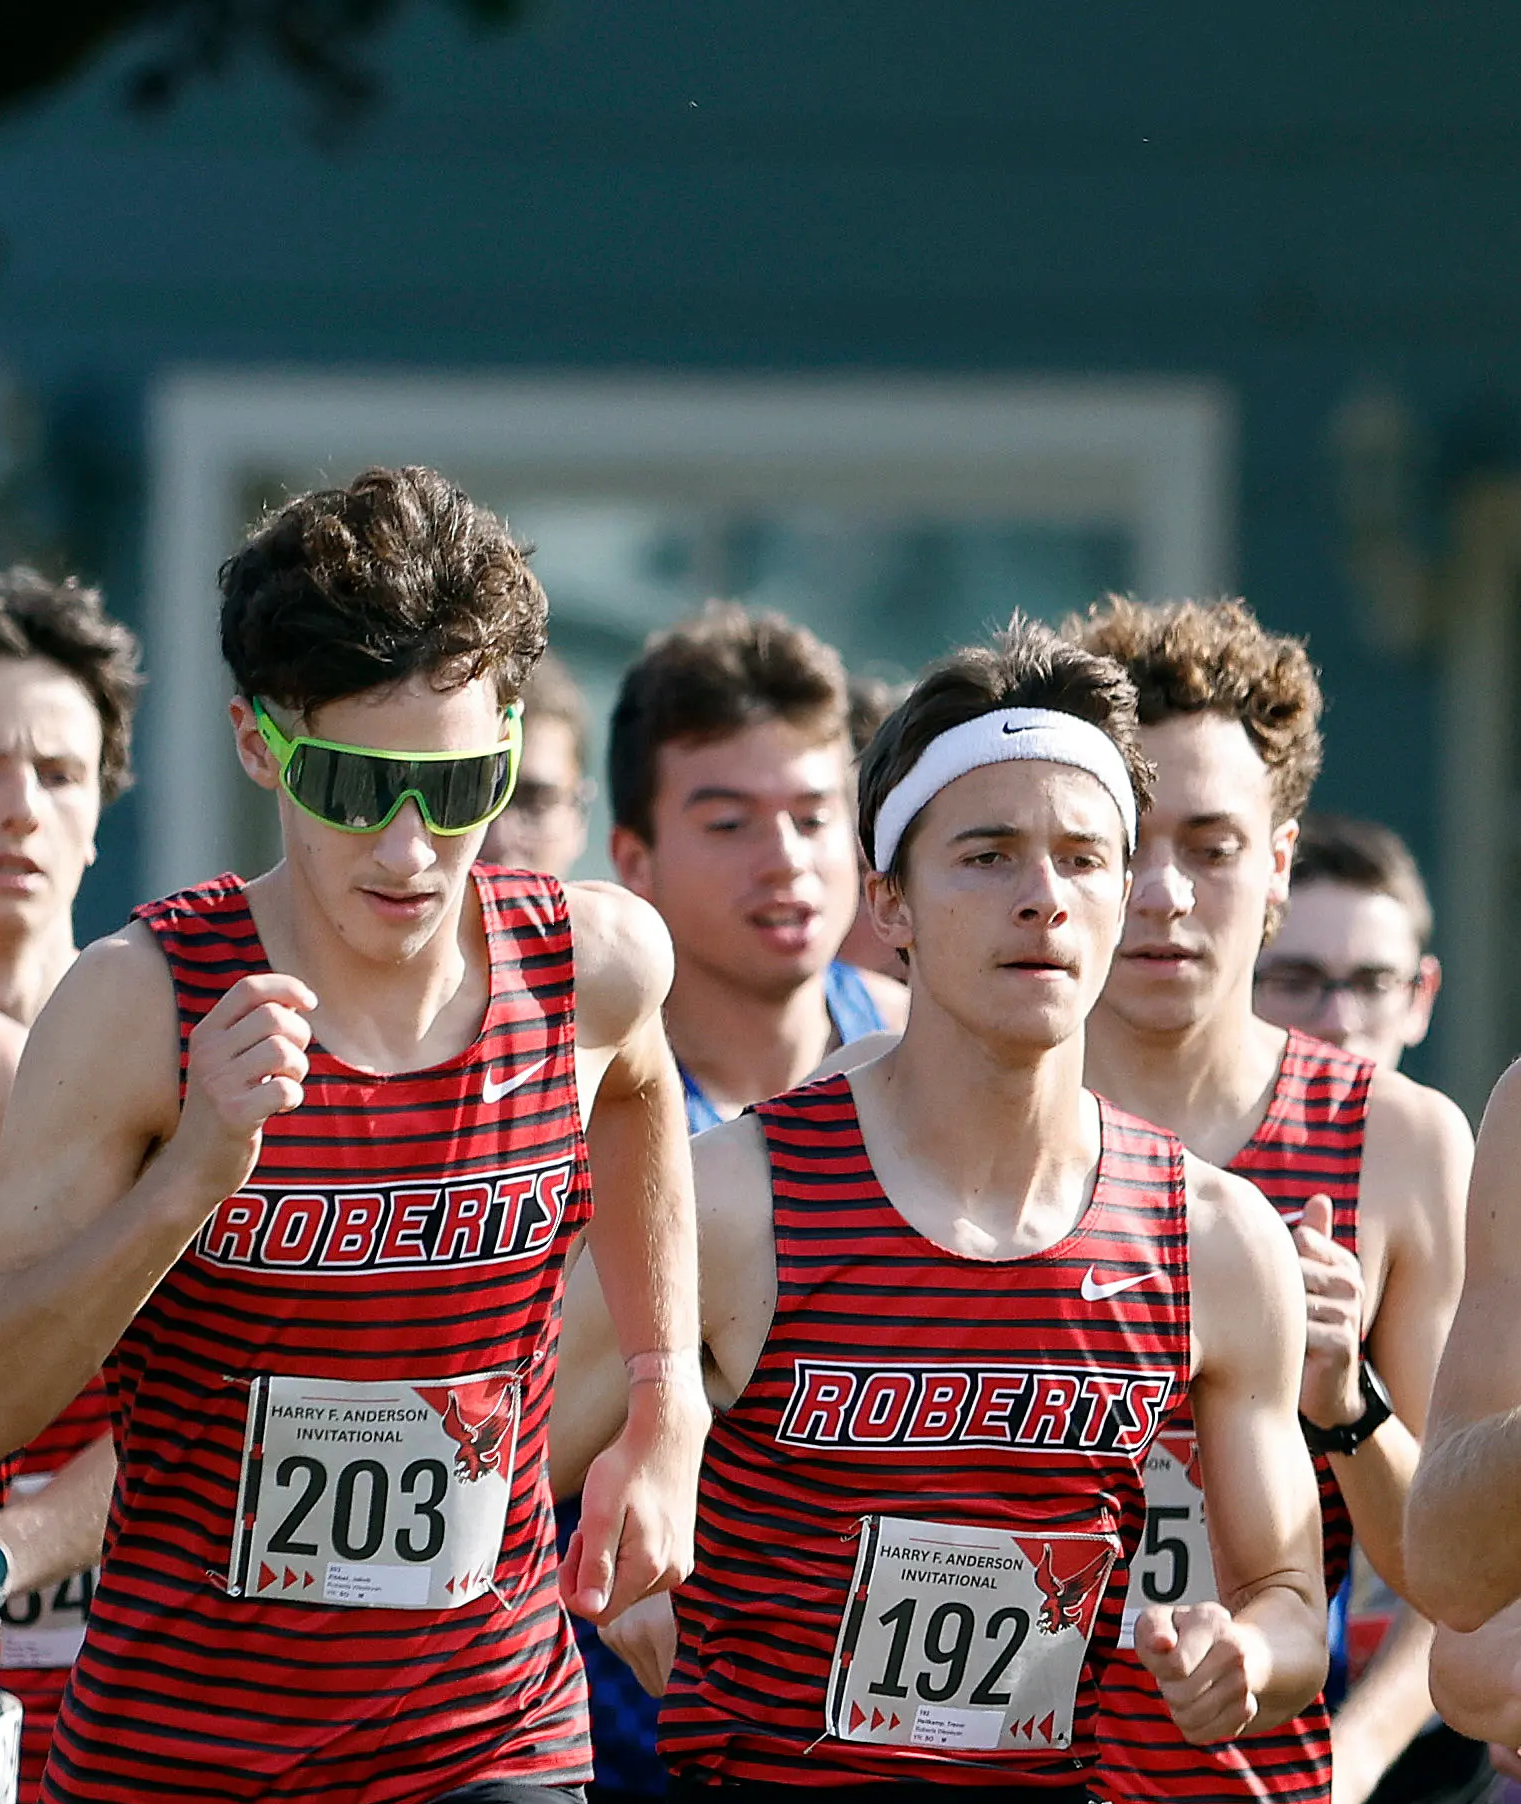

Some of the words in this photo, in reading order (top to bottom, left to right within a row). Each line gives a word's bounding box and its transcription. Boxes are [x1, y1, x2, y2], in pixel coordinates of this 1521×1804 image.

[204, 1165, 570, 1267] ROBERTS
[271, 1405, 325, 1421] HARRY
[329, 1408, 339, 1422] F.
[342, 1408, 428, 1423] ANDERSON
[786, 1368, 1166, 1449] ROBERTS
[296, 1428, 404, 1443] INVITATIONAL
[266, 1454, 449, 1563] 203
[880, 1545, 930, 1563] HARRY
[932, 1551, 943, 1565] F.
[945, 1553, 1024, 1571] ANDERSON
[900, 1569, 998, 1590] INVITATIONAL
[868, 1598, 1030, 1706] 192
